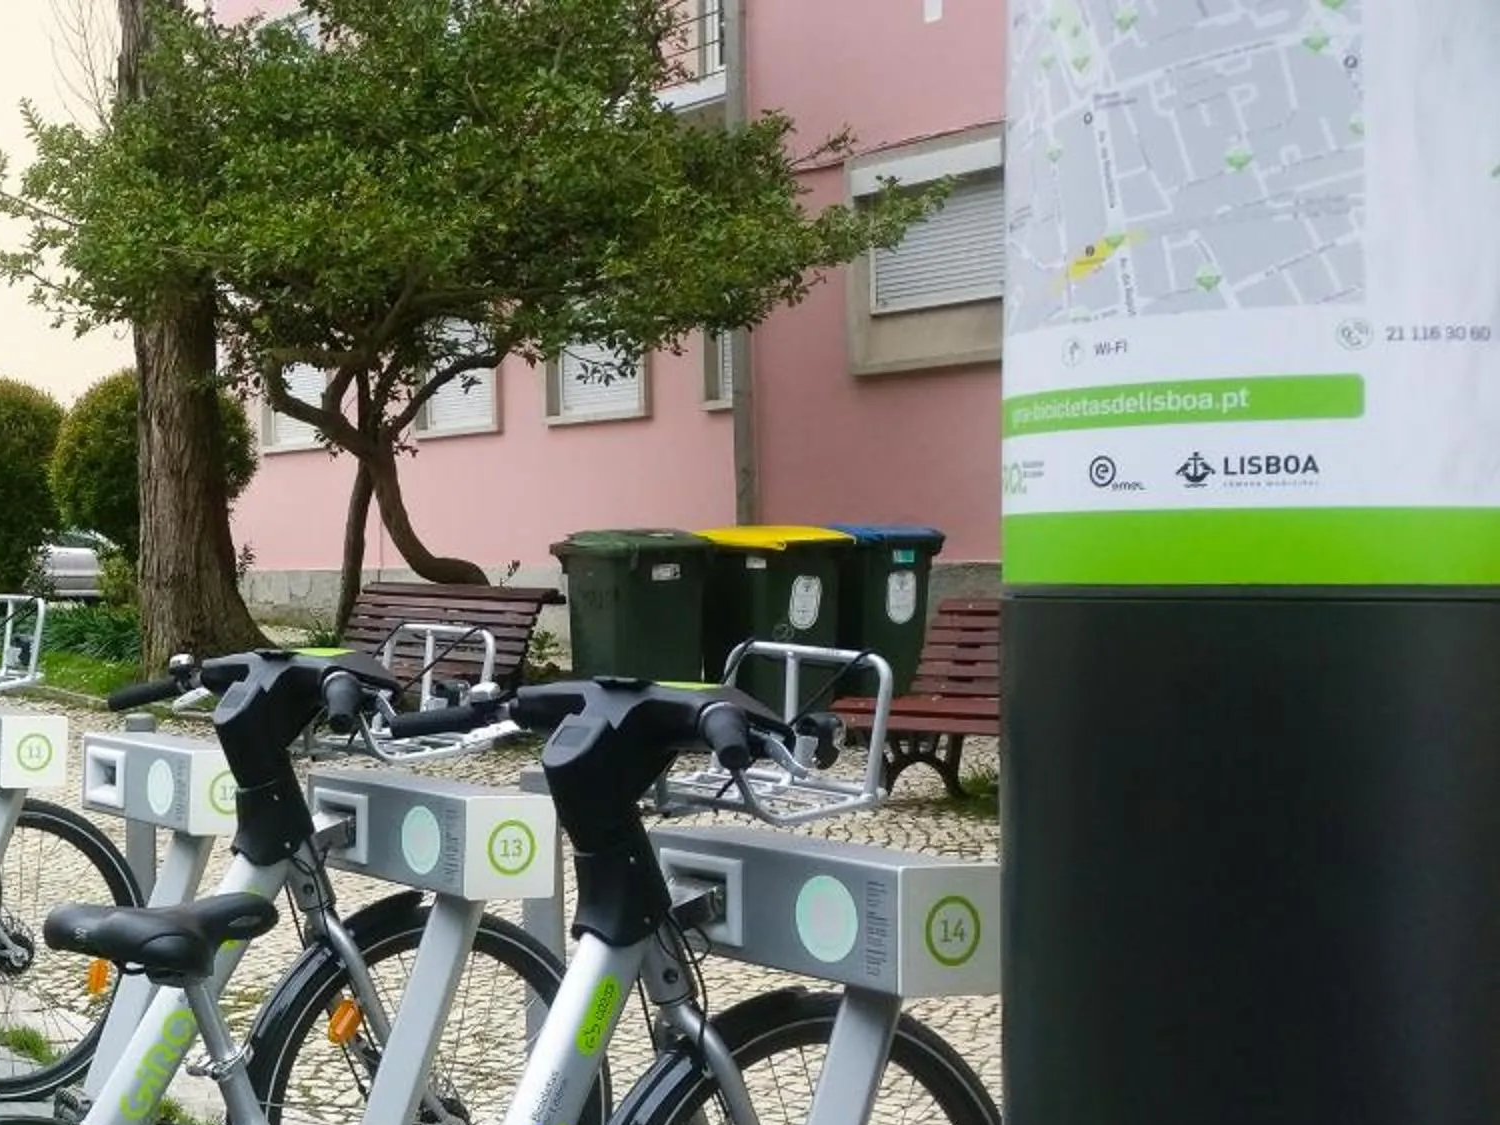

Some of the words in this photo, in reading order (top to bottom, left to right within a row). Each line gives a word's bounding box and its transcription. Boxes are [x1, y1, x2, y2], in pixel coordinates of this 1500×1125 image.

[1222, 455, 1320, 476] LISBOA
[499, 838, 524, 857] 13
[939, 918, 966, 943] 14
